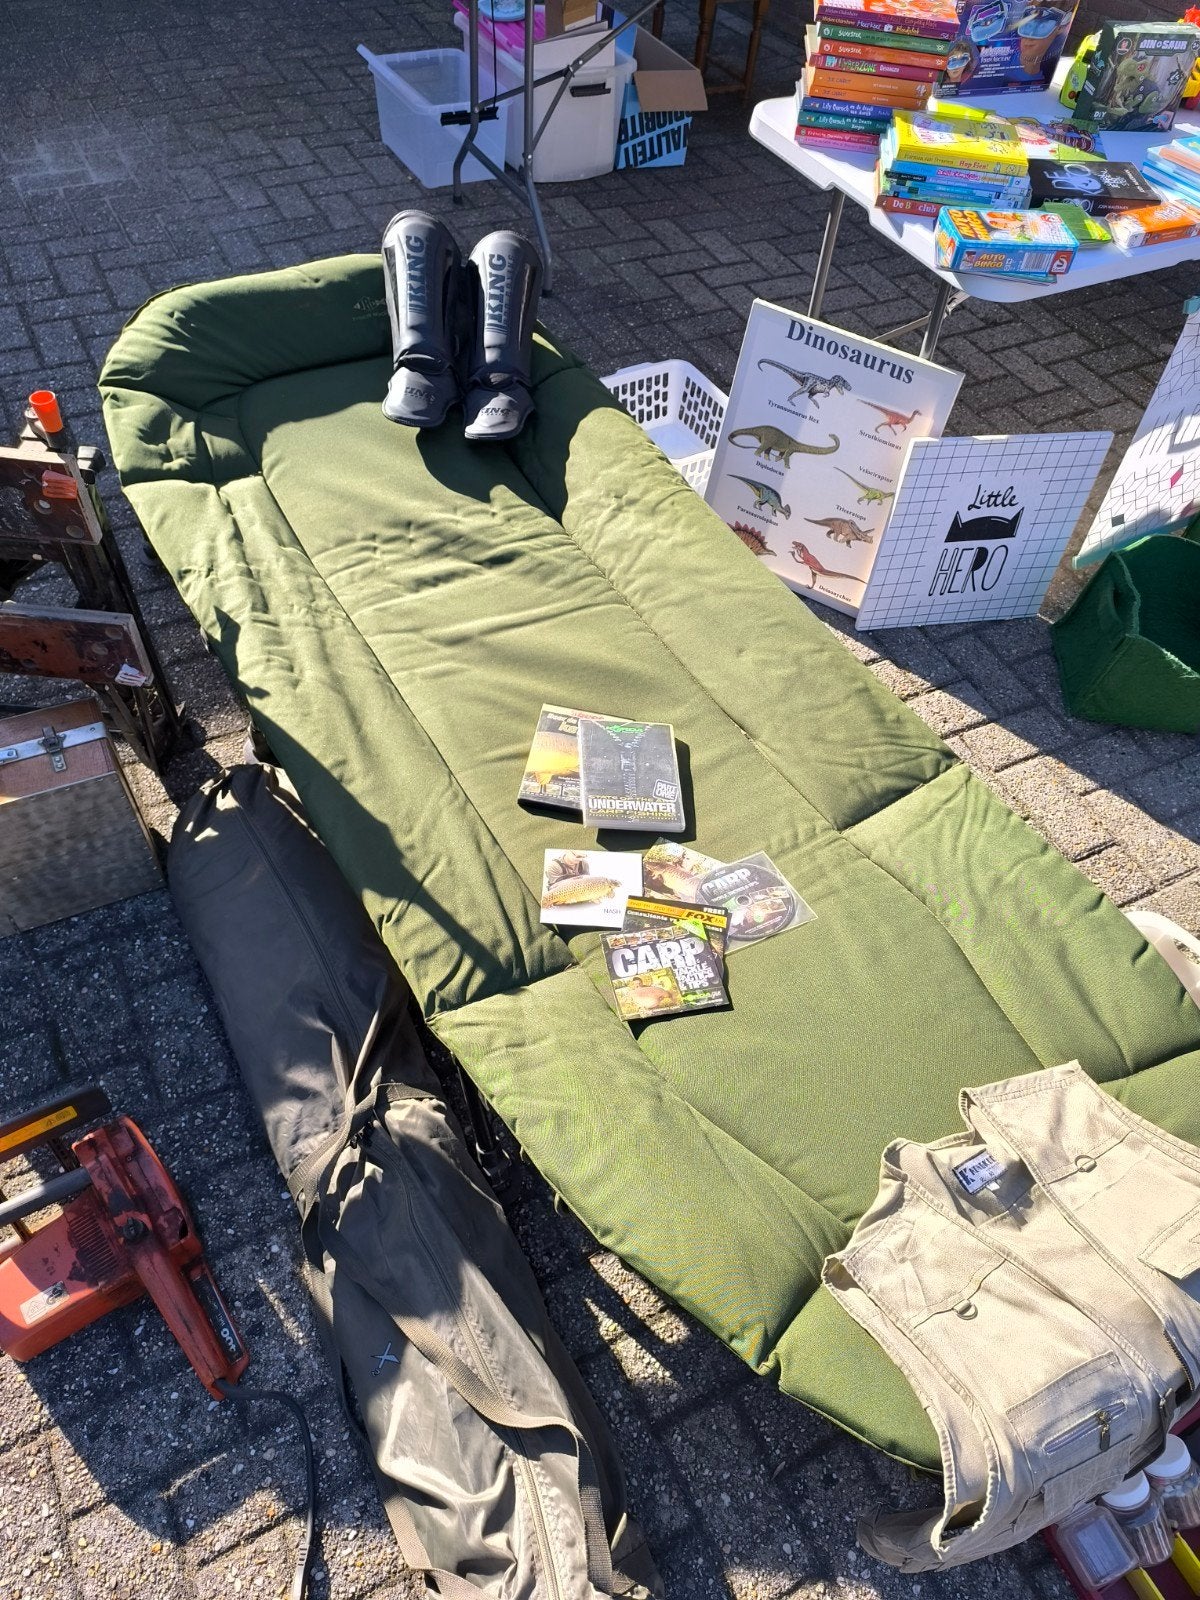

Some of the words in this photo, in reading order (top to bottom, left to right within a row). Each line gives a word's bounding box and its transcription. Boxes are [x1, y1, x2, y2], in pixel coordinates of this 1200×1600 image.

[405, 235, 427, 305] KING
[974, 260, 1003, 268] BINGO
[980, 253, 1005, 261] AUTO
[487, 253, 508, 323] KING
[786, 318, 915, 385] Dinosaurus
[808, 414, 820, 425] Rex
[967, 484, 1020, 511] Little
[928, 545, 1009, 597] HERO
[588, 798, 676, 813] UNDERWATER
[702, 868, 751, 897] CARP
[685, 911, 715, 923] FOX
[612, 937, 705, 978] CARP
